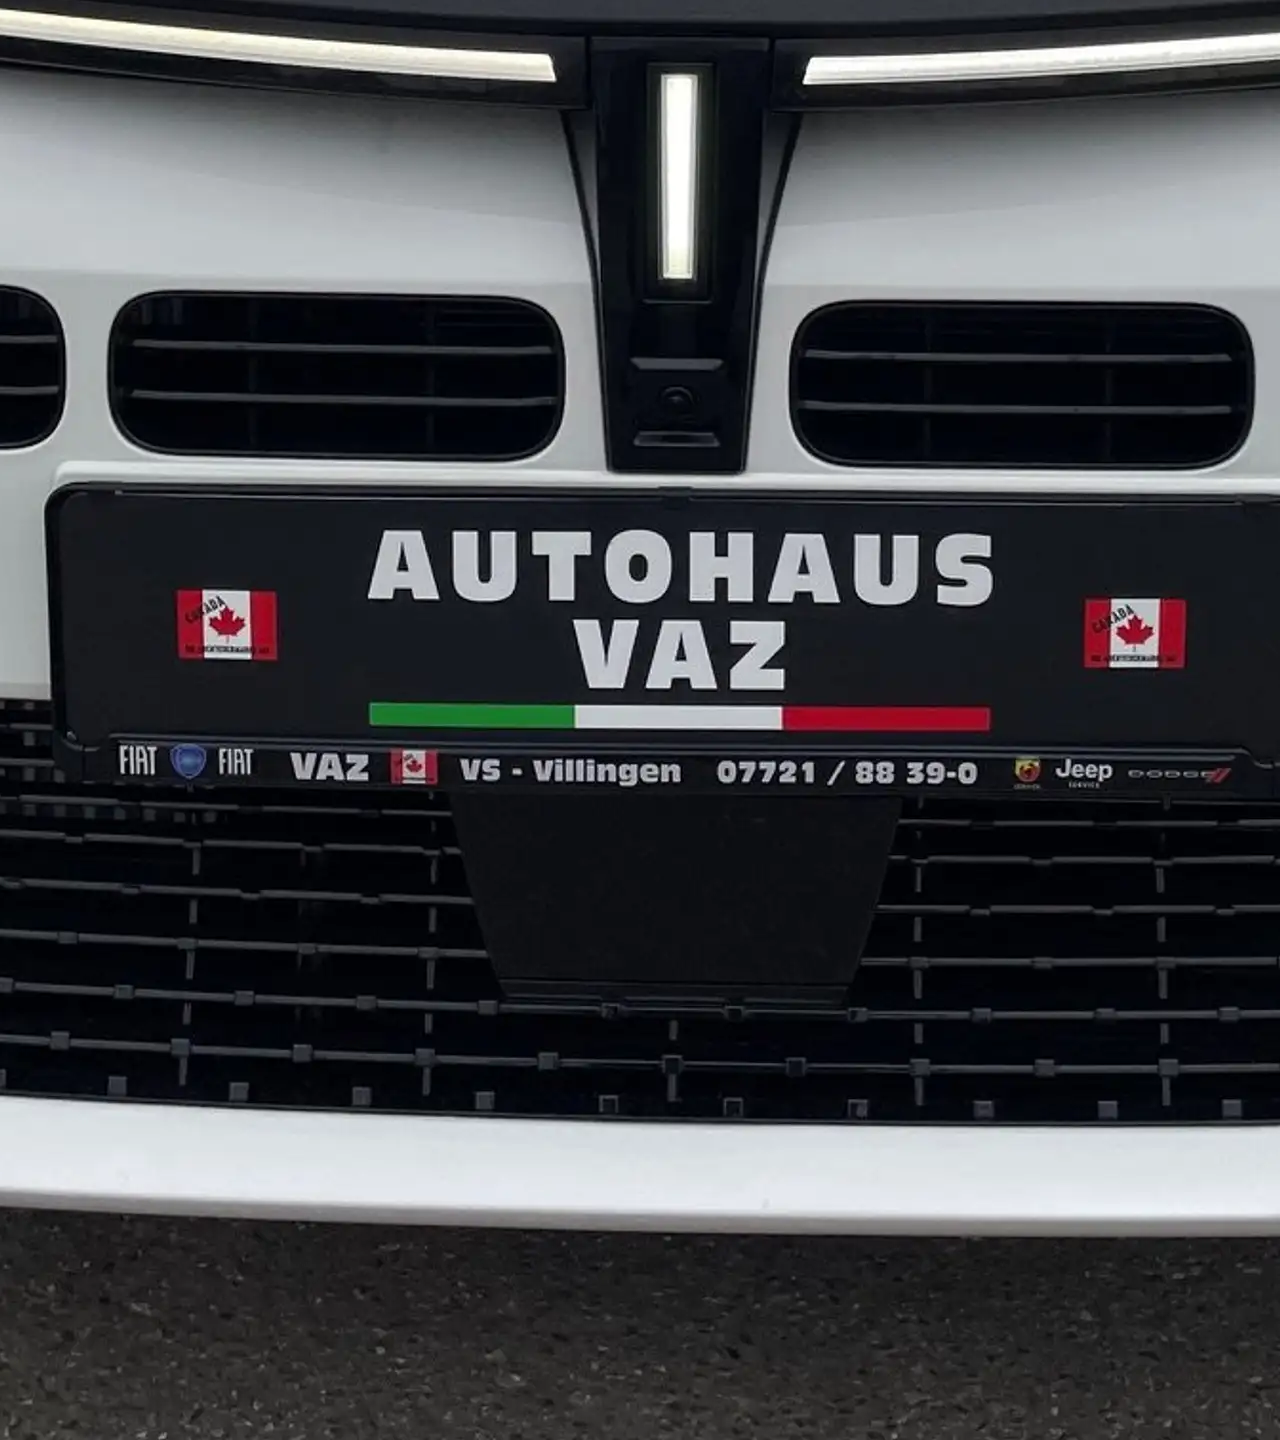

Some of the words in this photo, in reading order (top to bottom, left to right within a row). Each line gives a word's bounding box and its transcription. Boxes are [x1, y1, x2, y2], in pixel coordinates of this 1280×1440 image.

[368, 529, 993, 606] AUTOHAUS
[573, 620, 785, 690] VAZ
[120, 745, 157, 775] FIAT
[219, 748, 253, 775] FIAT
[290, 752, 369, 781] VAZ
[459, 758, 501, 781] VS
[532, 758, 681, 786] Villingen
[717, 760, 815, 784] 07721
[826, 760, 846, 786] /
[855, 762, 895, 784] 88
[906, 762, 978, 784] 39-0
[1055, 758, 1113, 782] Jeep
